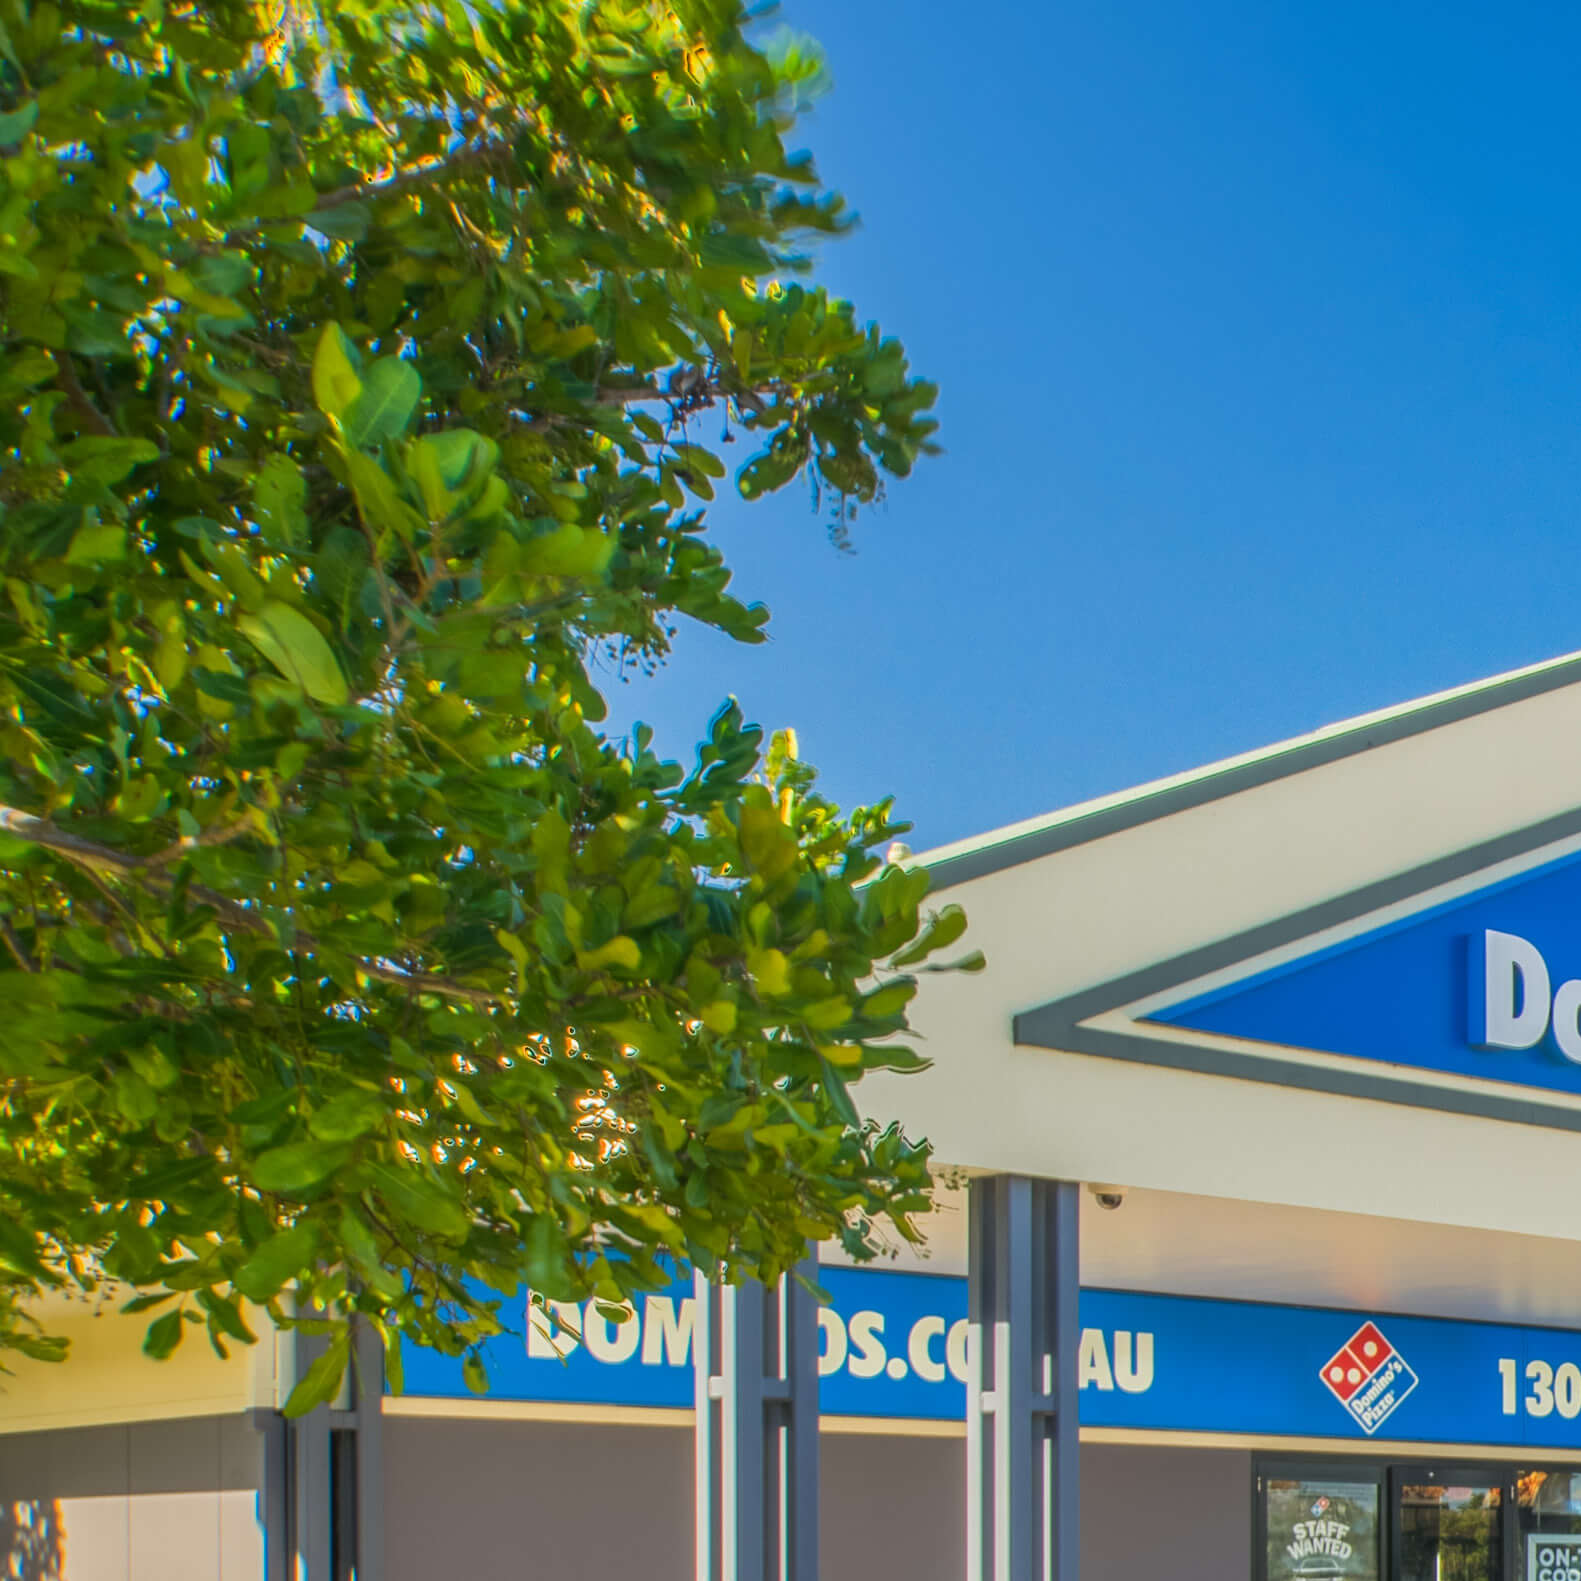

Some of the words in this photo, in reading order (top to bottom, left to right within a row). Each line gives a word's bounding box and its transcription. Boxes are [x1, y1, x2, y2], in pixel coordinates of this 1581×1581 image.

[1350, 1361, 1403, 1414] Domino's
[1360, 1391, 1395, 1427] Pizza
[1292, 1519, 1351, 1542] STAFF
[1286, 1537, 1352, 1560] WANTED
